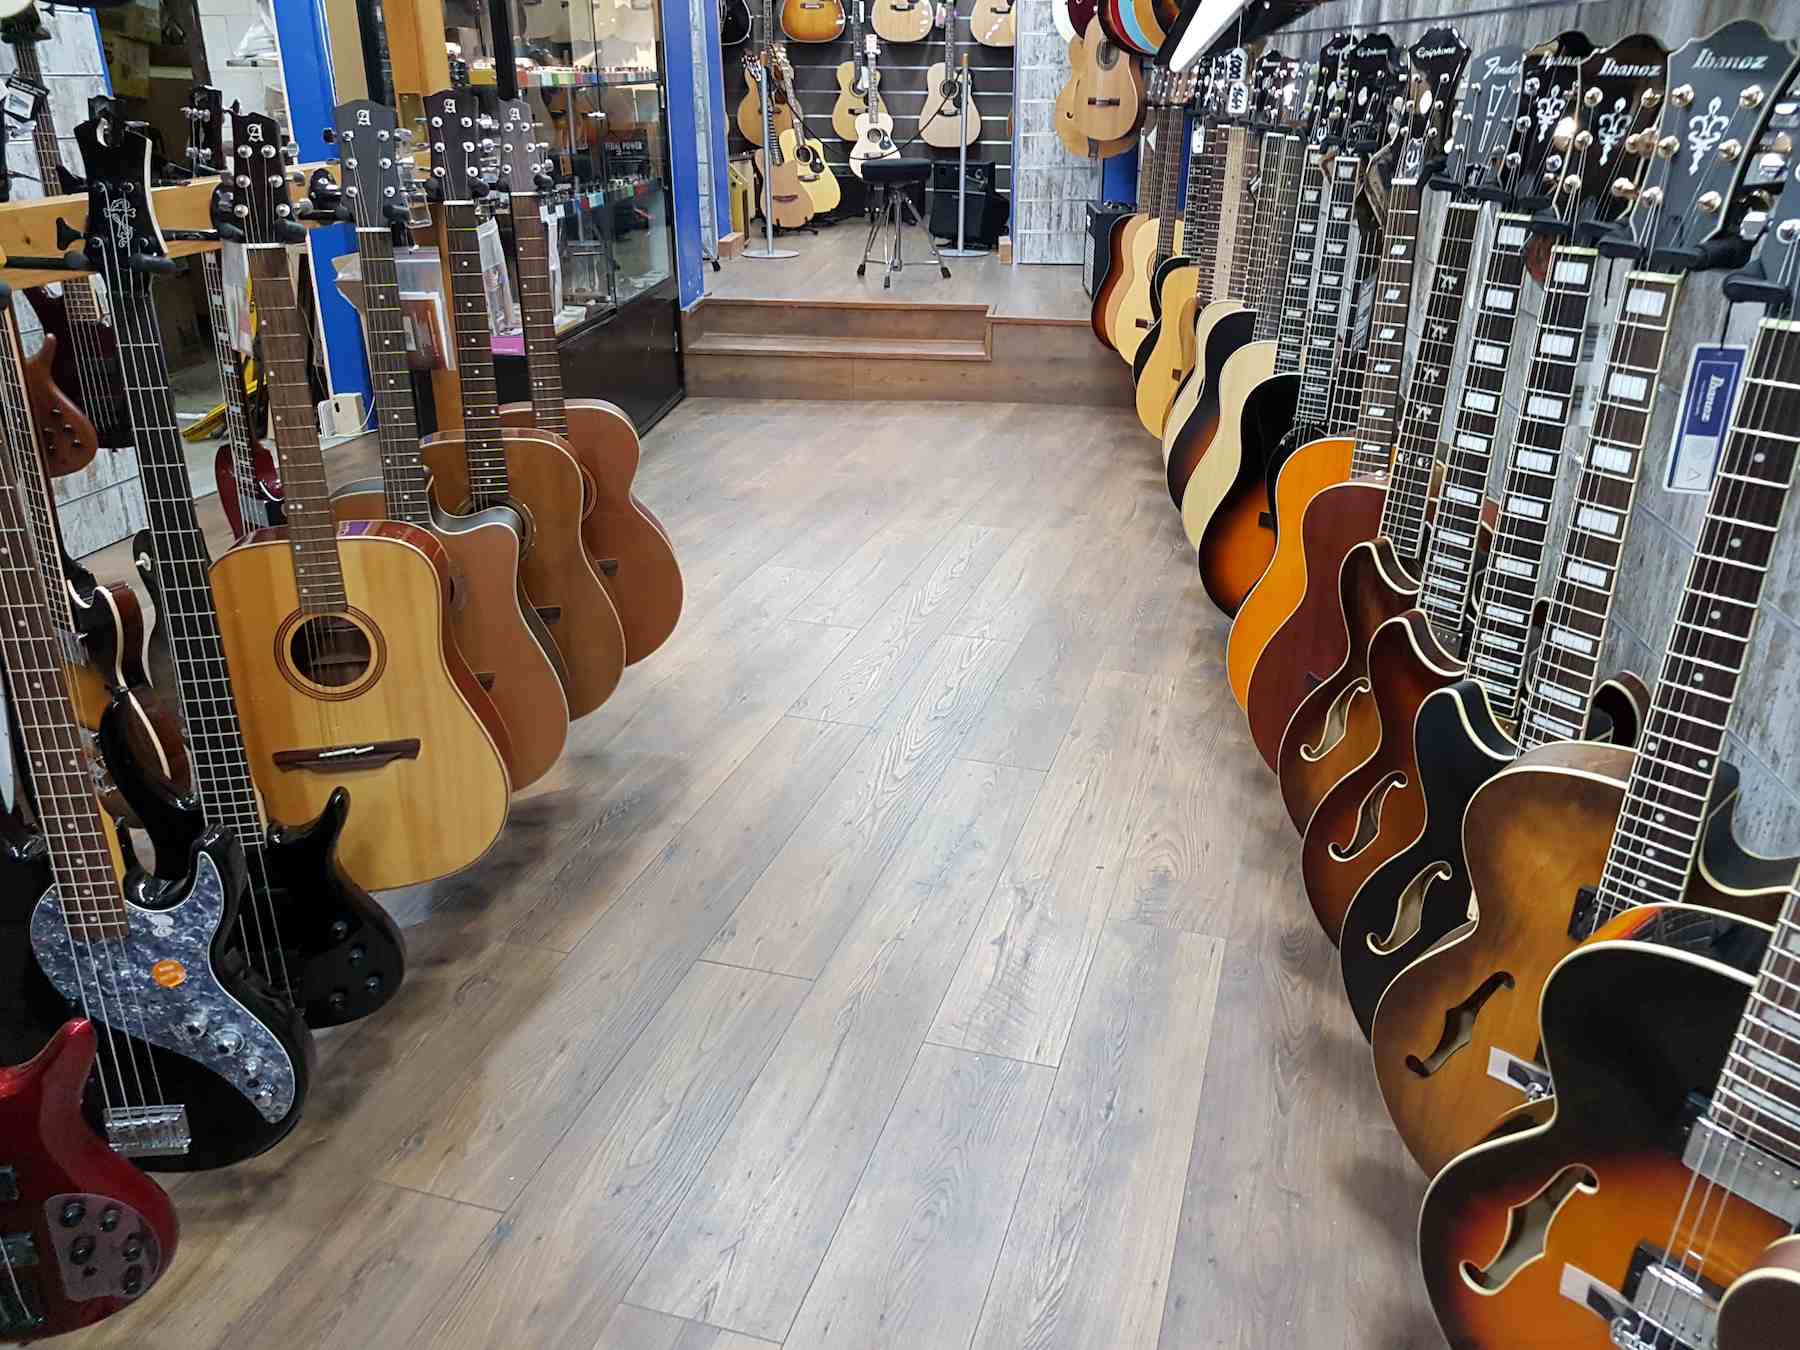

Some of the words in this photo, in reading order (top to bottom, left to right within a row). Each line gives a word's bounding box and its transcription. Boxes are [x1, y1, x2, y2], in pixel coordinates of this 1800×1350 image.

[1538, 52, 1579, 66] Ibane
[1598, 57, 1662, 77] Ibanez
[1692, 48, 1769, 70] Ibanez
